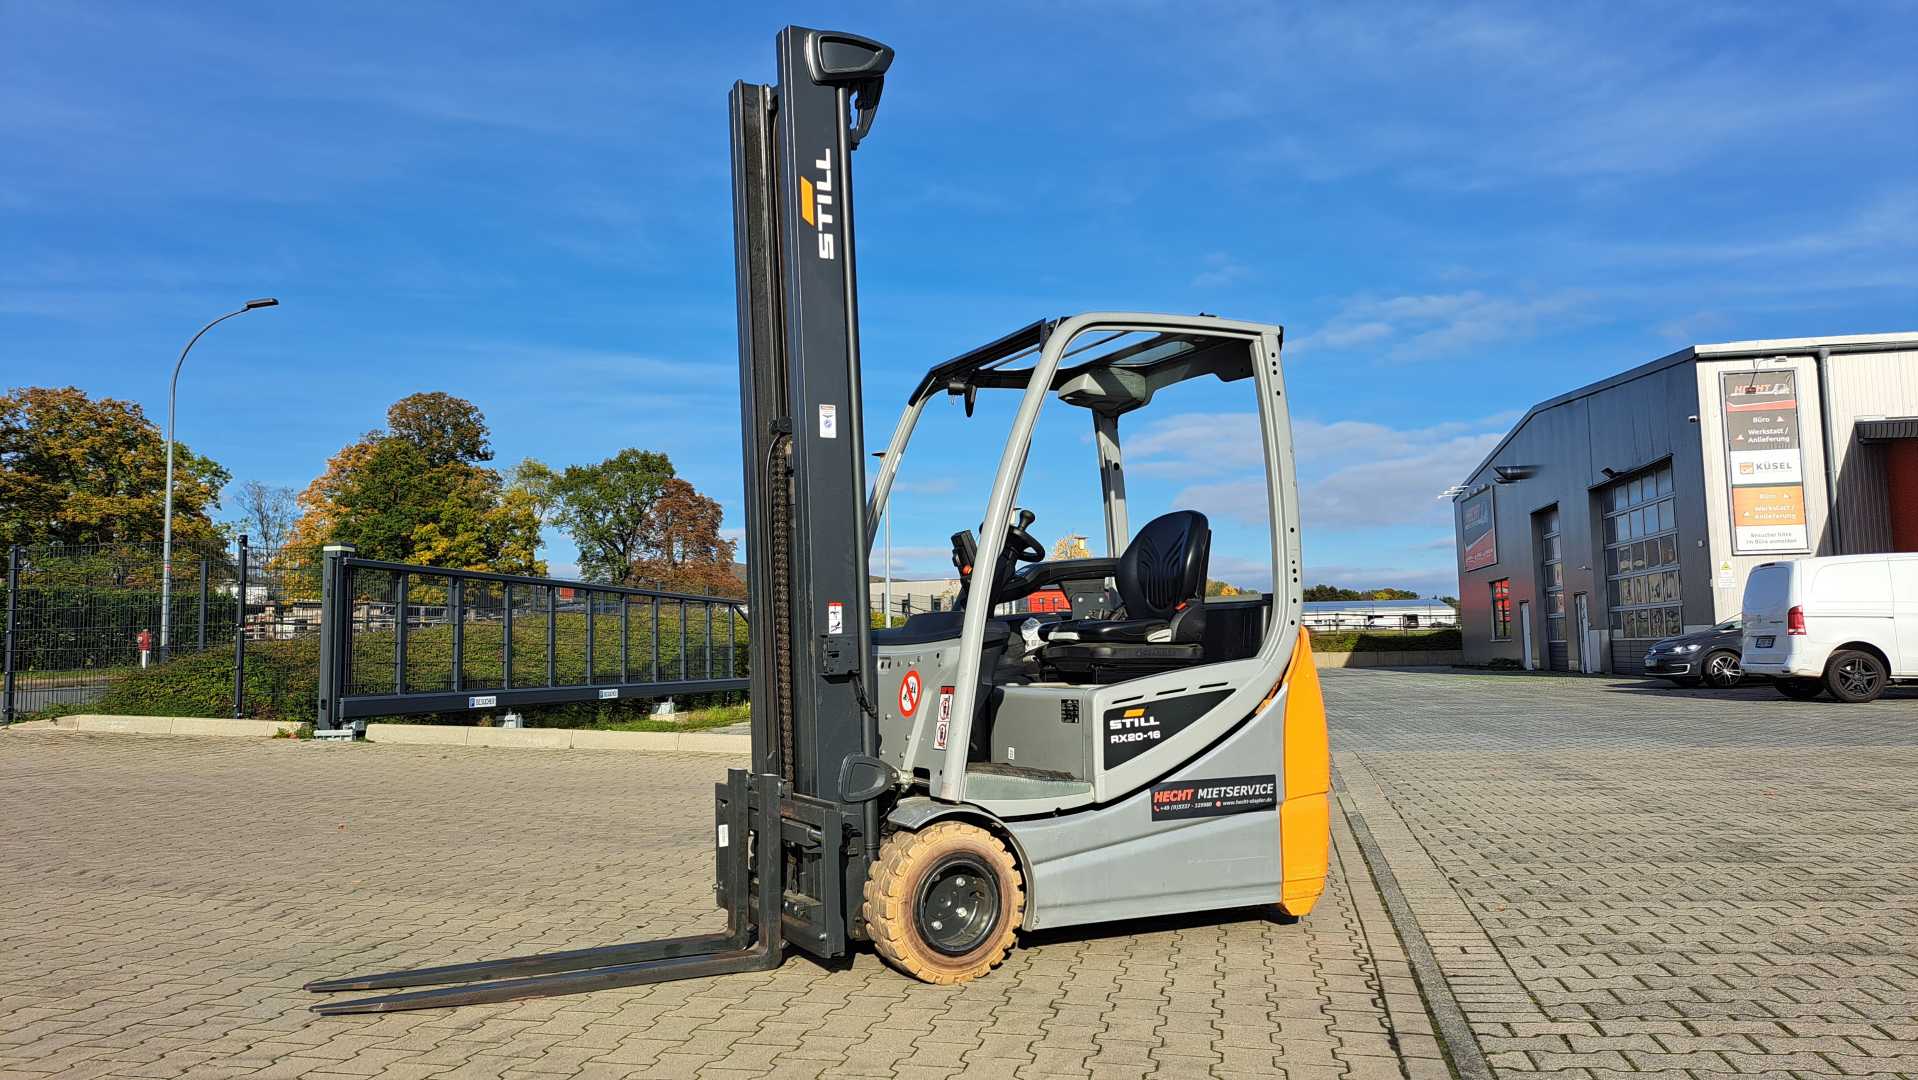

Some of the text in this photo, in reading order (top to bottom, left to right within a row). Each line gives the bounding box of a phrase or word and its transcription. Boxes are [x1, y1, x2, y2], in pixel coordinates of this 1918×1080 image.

[815, 148, 835, 260] STILL
[1748, 427, 1783, 435] Werkstatt
[1756, 461, 1793, 470] KÜSEL
[1109, 716, 1160, 730] STILL
[1110, 730, 1161, 744] RX20-16
[1154, 783, 1274, 803] HECHT MIETSERVICE
